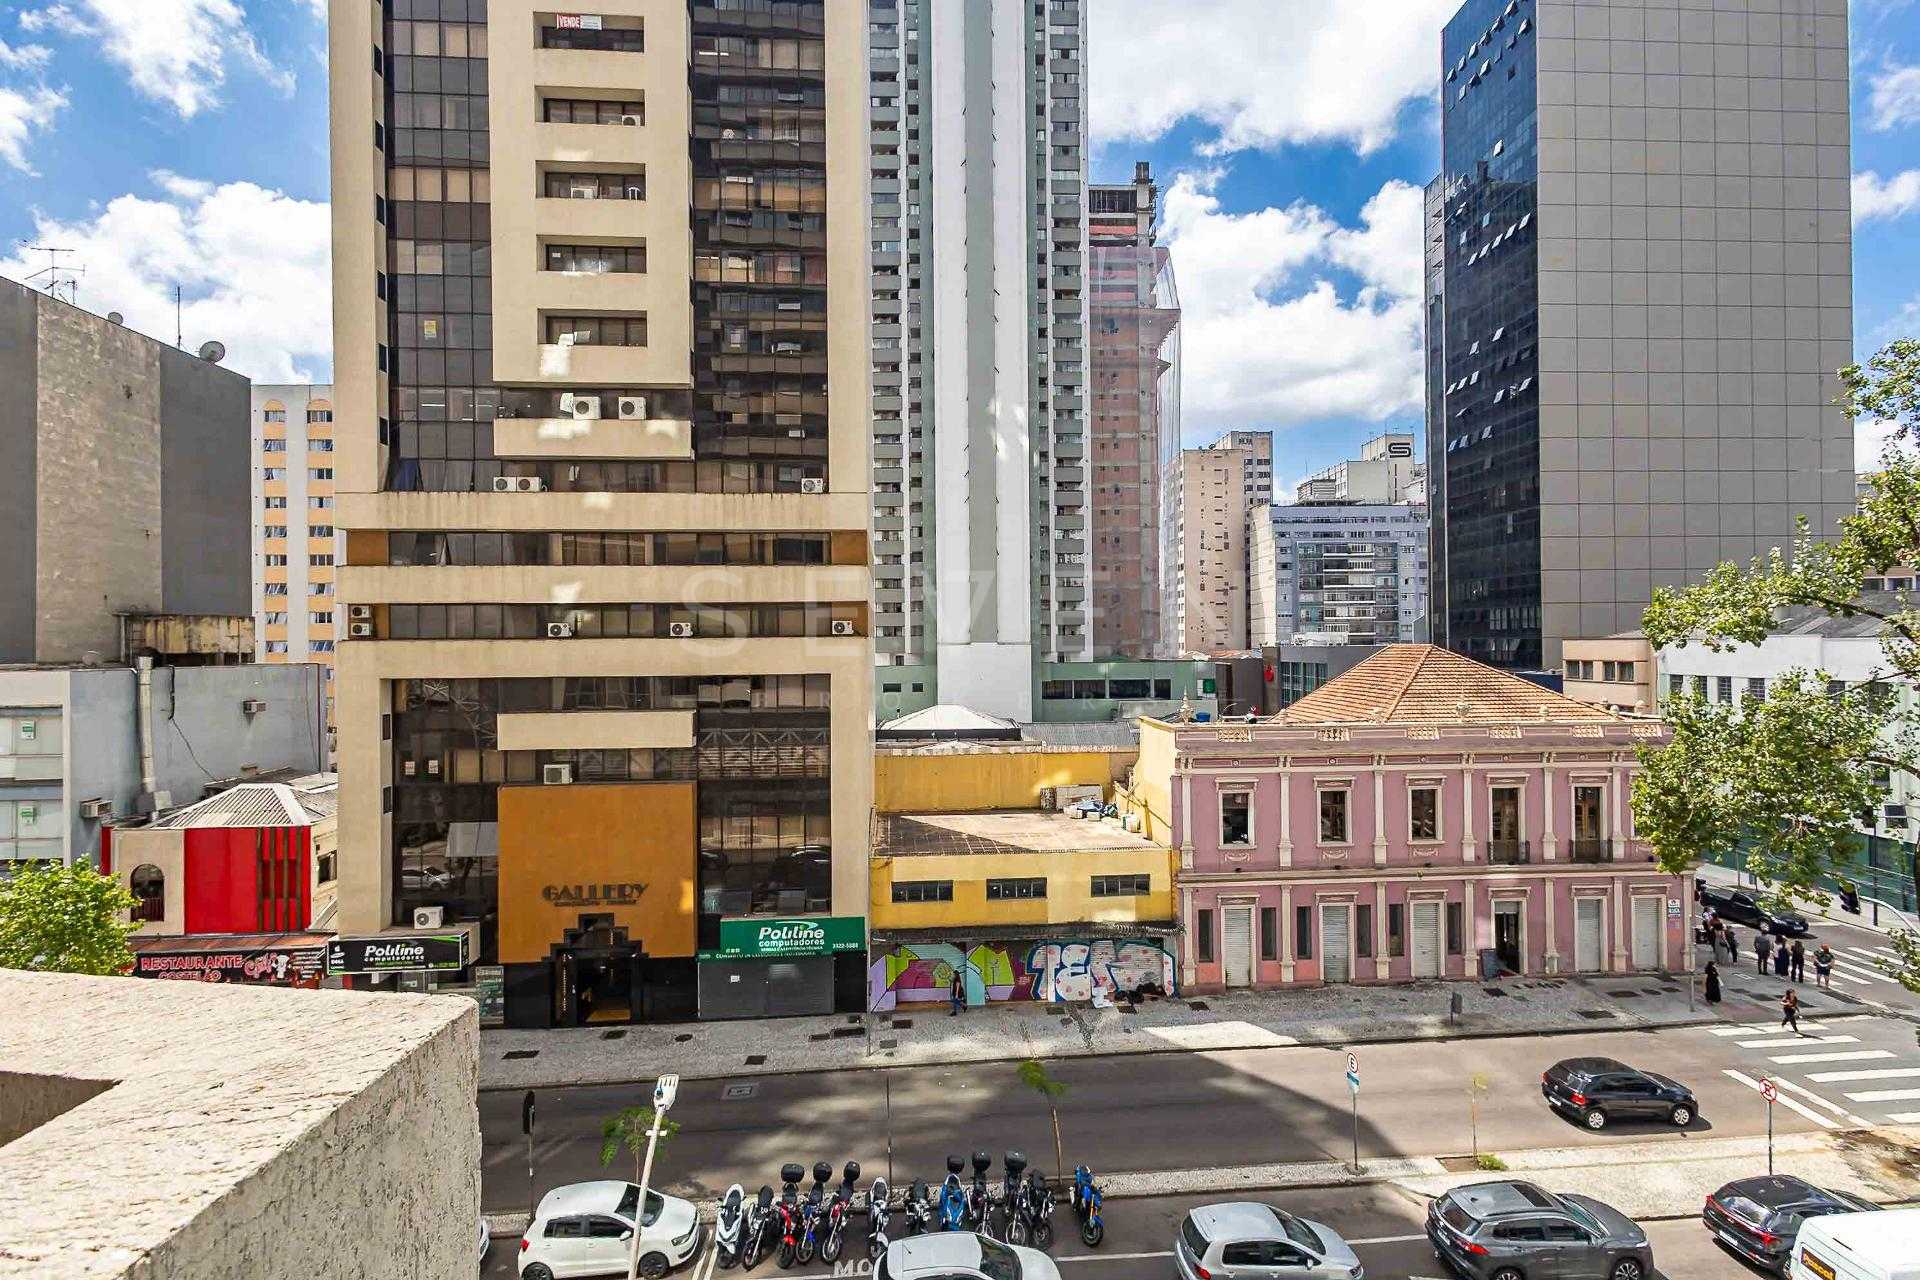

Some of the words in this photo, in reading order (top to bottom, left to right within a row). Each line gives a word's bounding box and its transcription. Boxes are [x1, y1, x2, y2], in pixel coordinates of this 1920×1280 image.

[542, 883, 649, 901] GALLERY
[759, 923, 825, 941] Poliline
[364, 943, 425, 957] Poliline
[759, 938, 825, 948] computadores
[140, 954, 243, 971] RESTAURANTE
